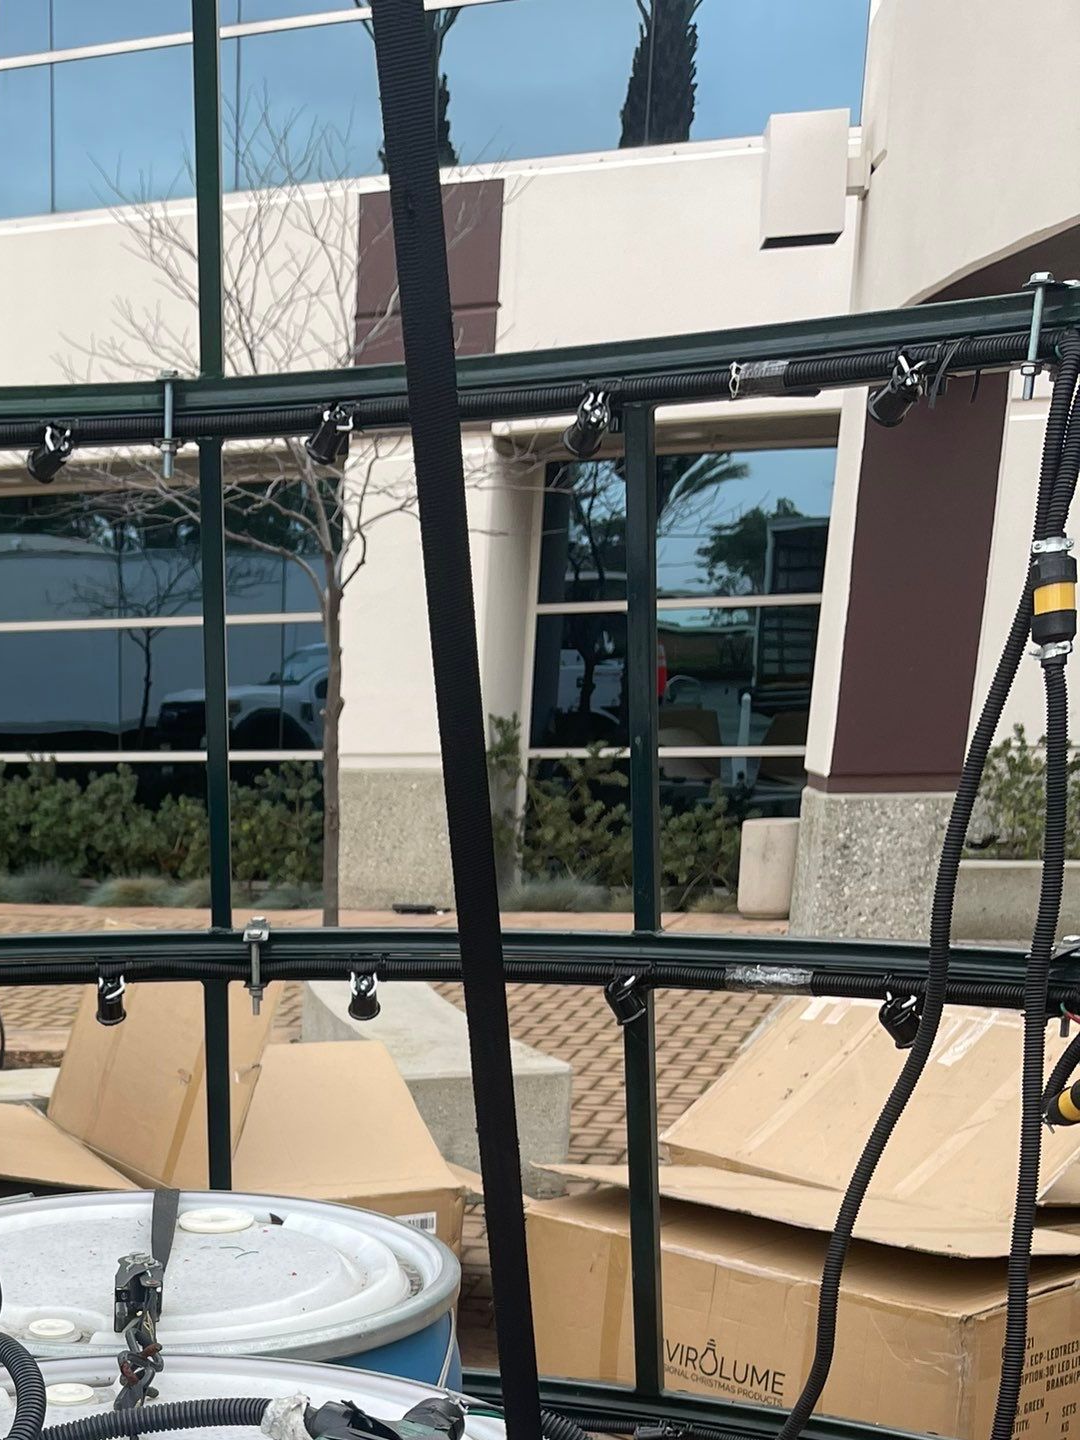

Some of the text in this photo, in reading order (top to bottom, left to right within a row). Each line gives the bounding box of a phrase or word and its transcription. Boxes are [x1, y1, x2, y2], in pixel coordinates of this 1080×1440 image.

[664, 1338, 786, 1396] VIROLUME
[690, 1372, 736, 1395] CHRISTMAS
[737, 1387, 784, 1408] PRODUCTS
[1024, 1396, 1045, 1414] GREEN
[1062, 1402, 1077, 1418] SETS
